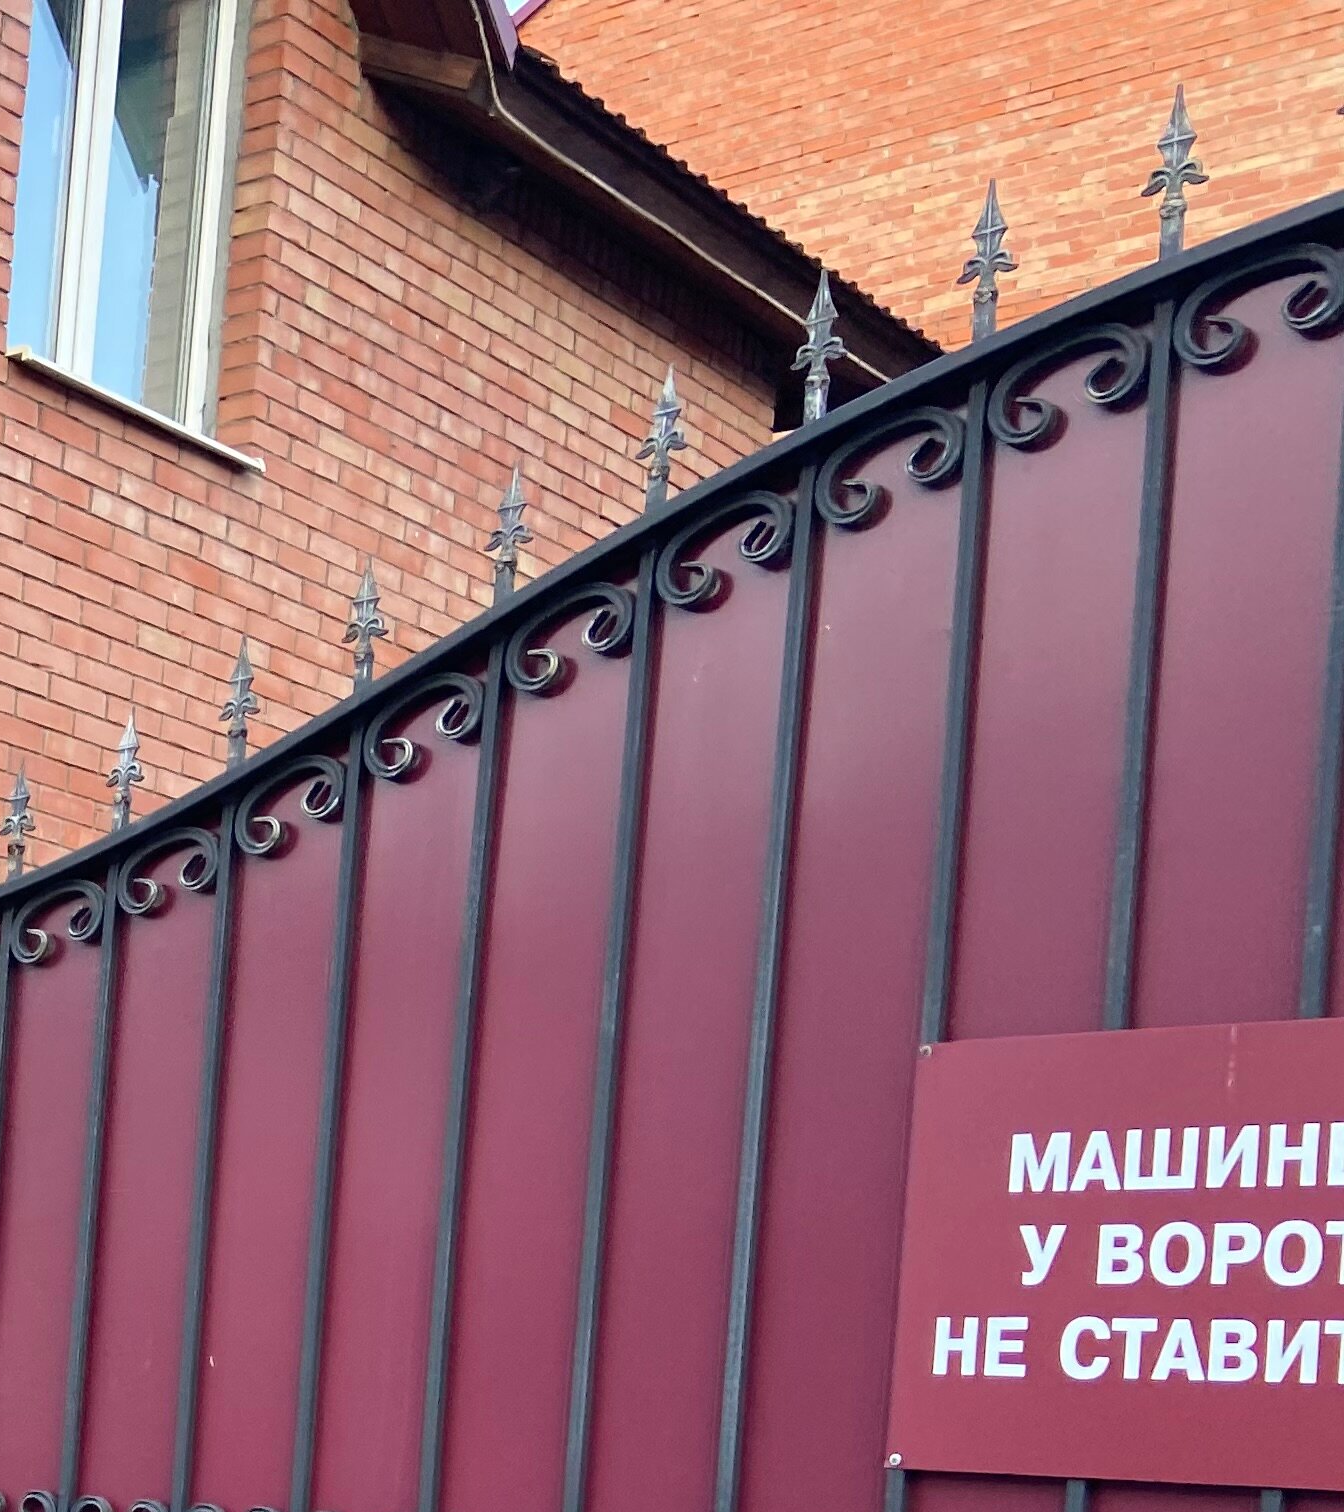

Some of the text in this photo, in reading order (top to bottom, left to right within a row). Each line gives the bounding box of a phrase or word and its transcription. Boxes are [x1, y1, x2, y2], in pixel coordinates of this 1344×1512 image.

[1008, 1121, 1344, 1193] МАШИН
[1018, 1223, 1067, 1287] У
[931, 1315, 1029, 1378] НЕ
